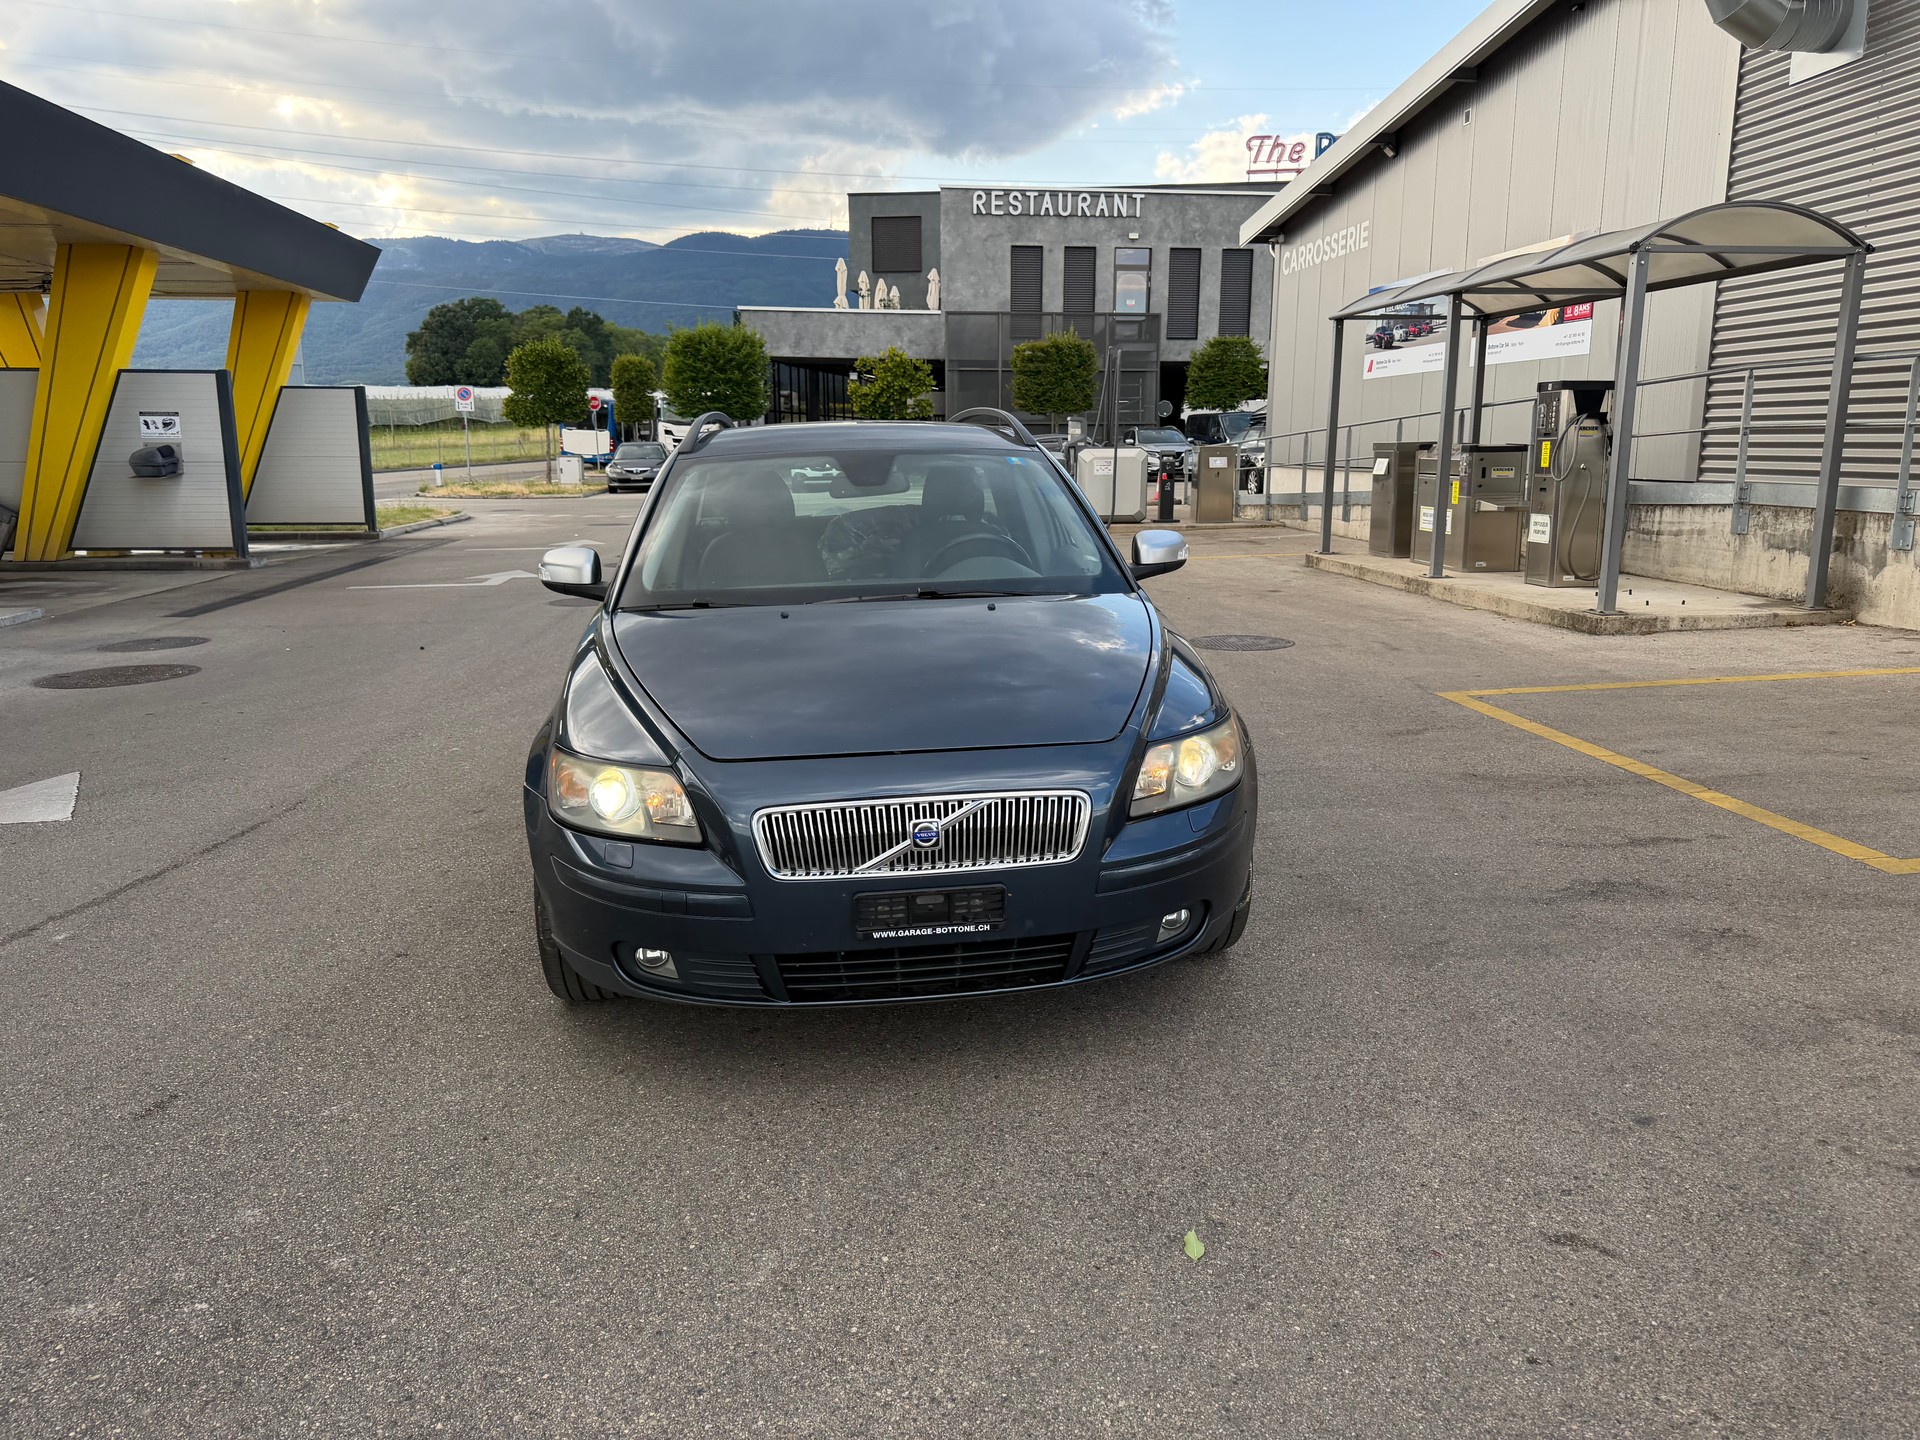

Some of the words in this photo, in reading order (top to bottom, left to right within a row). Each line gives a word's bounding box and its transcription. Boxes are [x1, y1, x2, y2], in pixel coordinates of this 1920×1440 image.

[1246, 134, 1306, 163] The
[972, 190, 1146, 218] RESTAURANT
[1282, 220, 1370, 276] CARROSSERIE
[1573, 305, 1579, 316] 8
[1579, 303, 1590, 312] ANS
[872, 924, 991, 939] WWW.GARAGE-BOTTONE.CH
